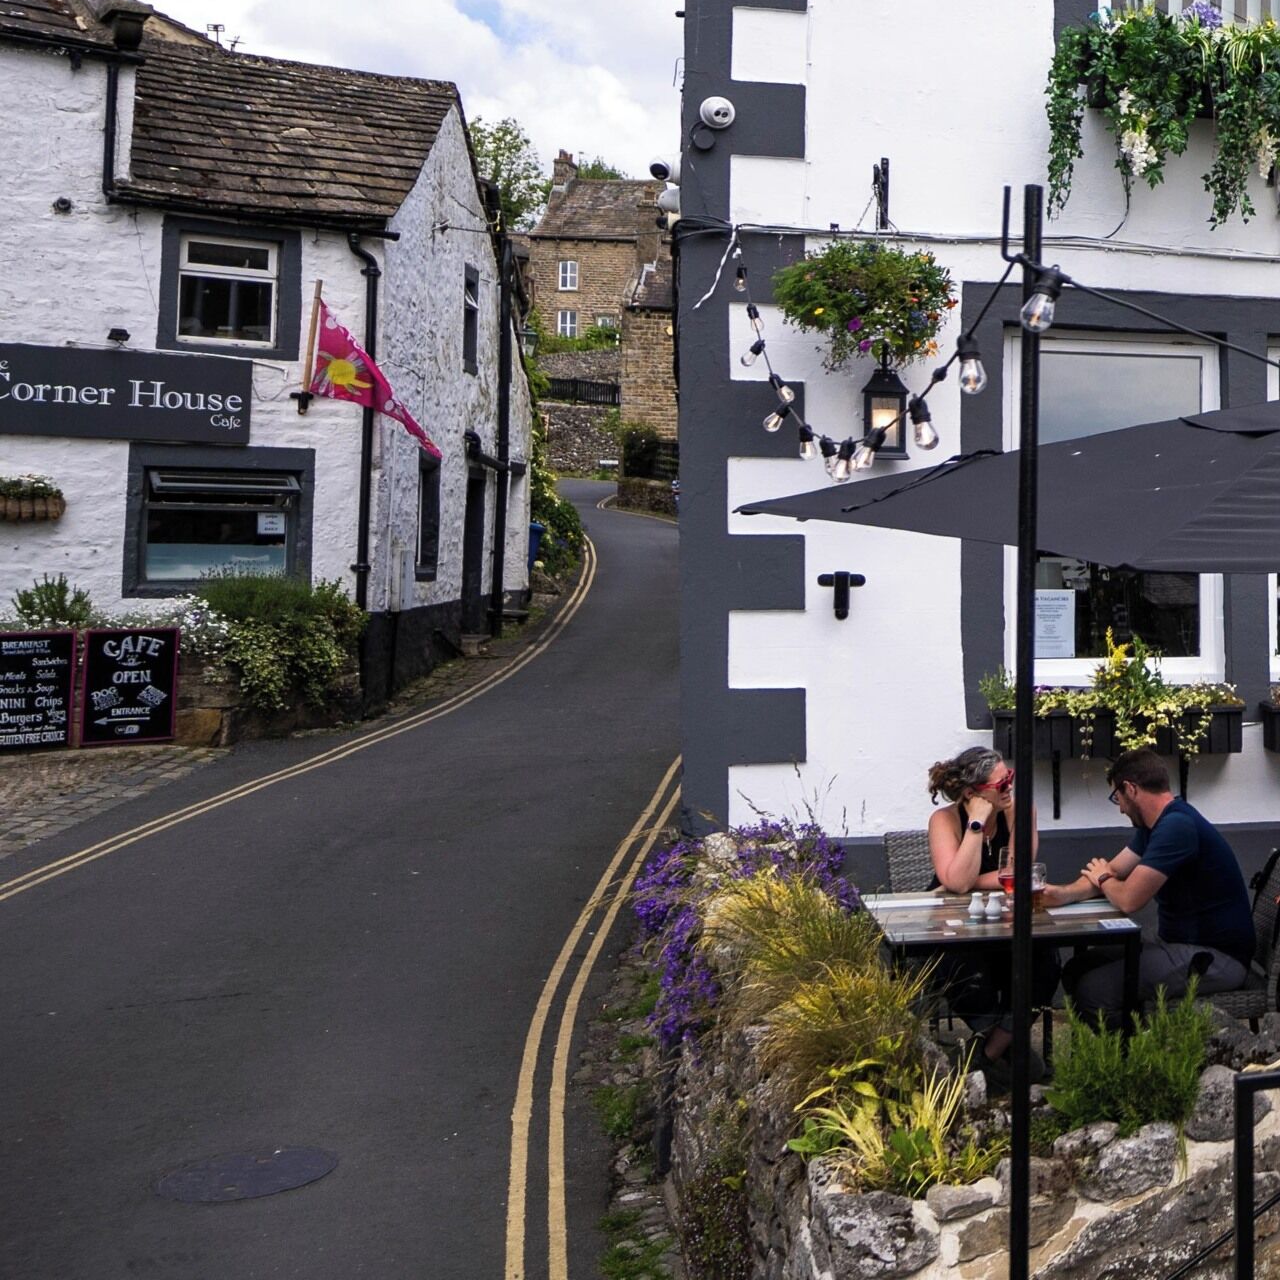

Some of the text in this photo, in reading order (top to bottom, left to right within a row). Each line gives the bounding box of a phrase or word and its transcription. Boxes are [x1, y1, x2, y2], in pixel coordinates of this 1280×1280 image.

[128, 379, 243, 412] House
[210, 414, 241, 430] Cafe
[2, 640, 51, 650] BREAKFAST
[104, 635, 165, 661] CAFE
[5, 671, 27, 680] Meals
[112, 670, 151, 683] OPEN
[91, 686, 118, 700] DOG
[35, 696, 63, 709] Chips
[111, 707, 151, 716] ENTRANCE
[0, 712, 42, 725] Burgers
[25, 732, 41, 743] FREE
[41, 730, 66, 742] CHOICE
